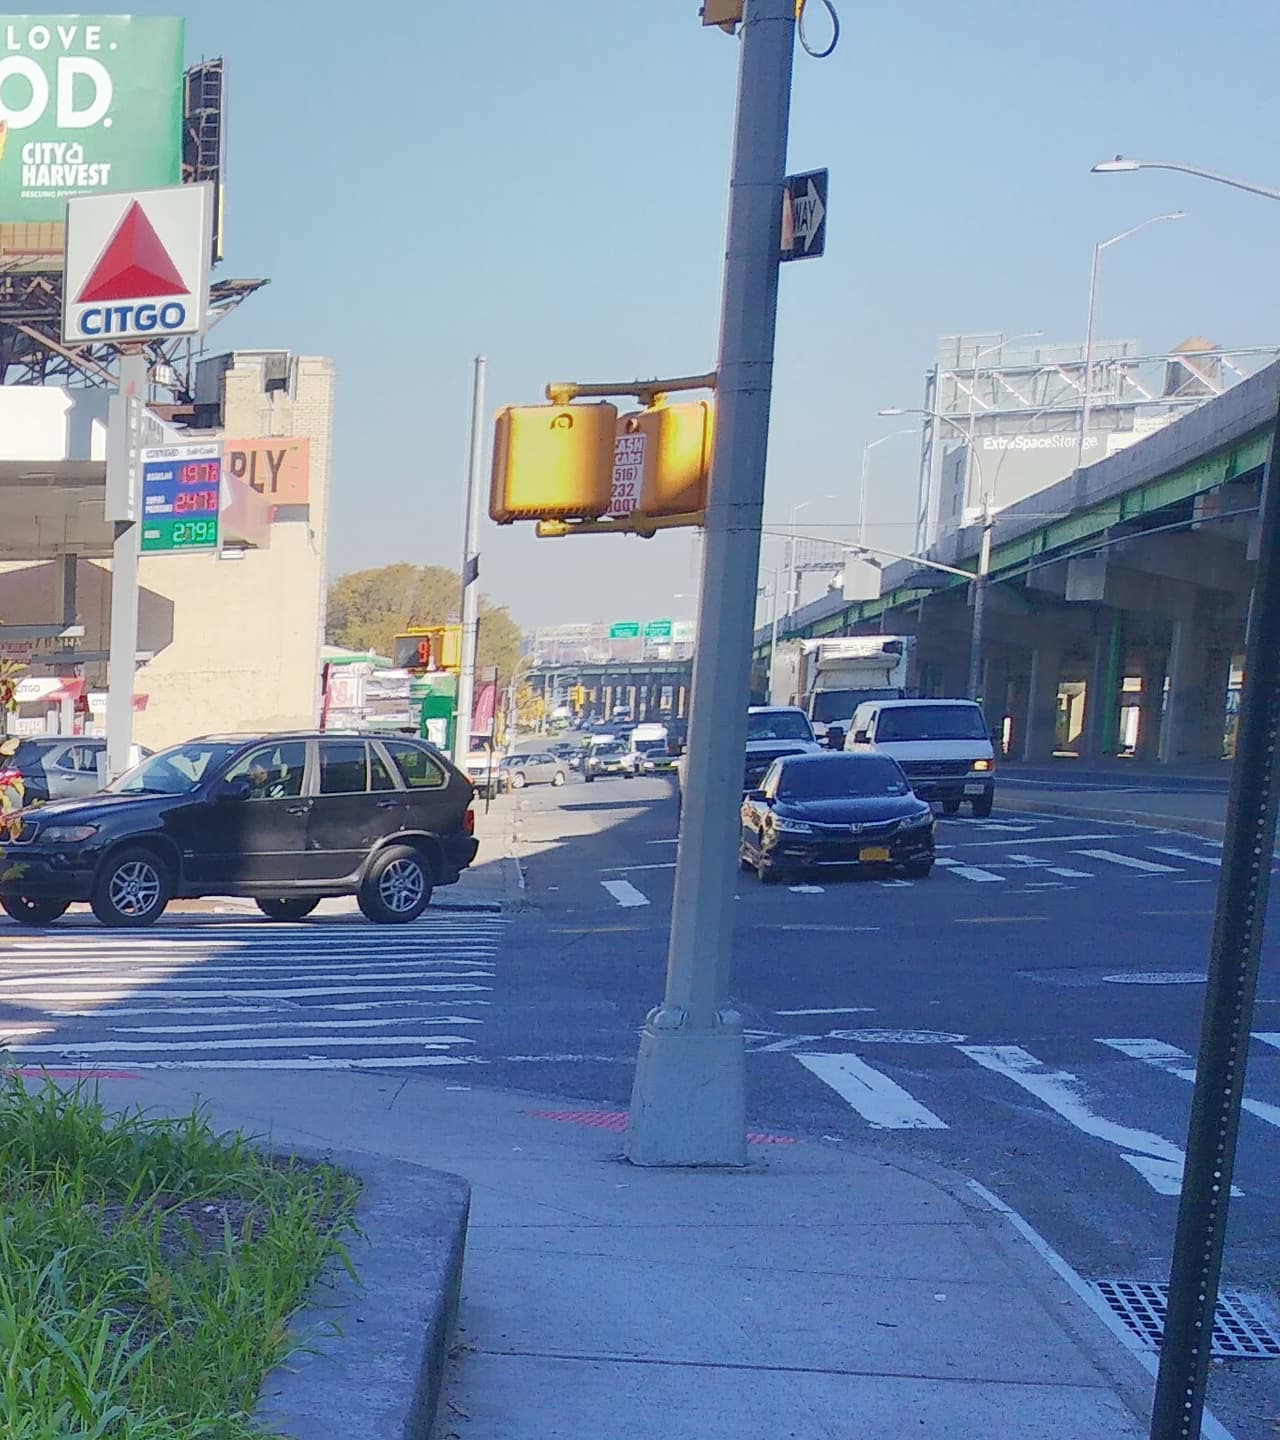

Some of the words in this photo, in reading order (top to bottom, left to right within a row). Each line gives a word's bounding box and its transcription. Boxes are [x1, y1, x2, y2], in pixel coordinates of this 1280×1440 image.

[6, 25, 118, 50] LOVE.
[22, 142, 67, 164] CITY
[21, 163, 111, 187] HARVEST
[793, 199, 817, 233] WAY
[80, 302, 186, 335] CITGO
[611, 483, 635, 498] 232
